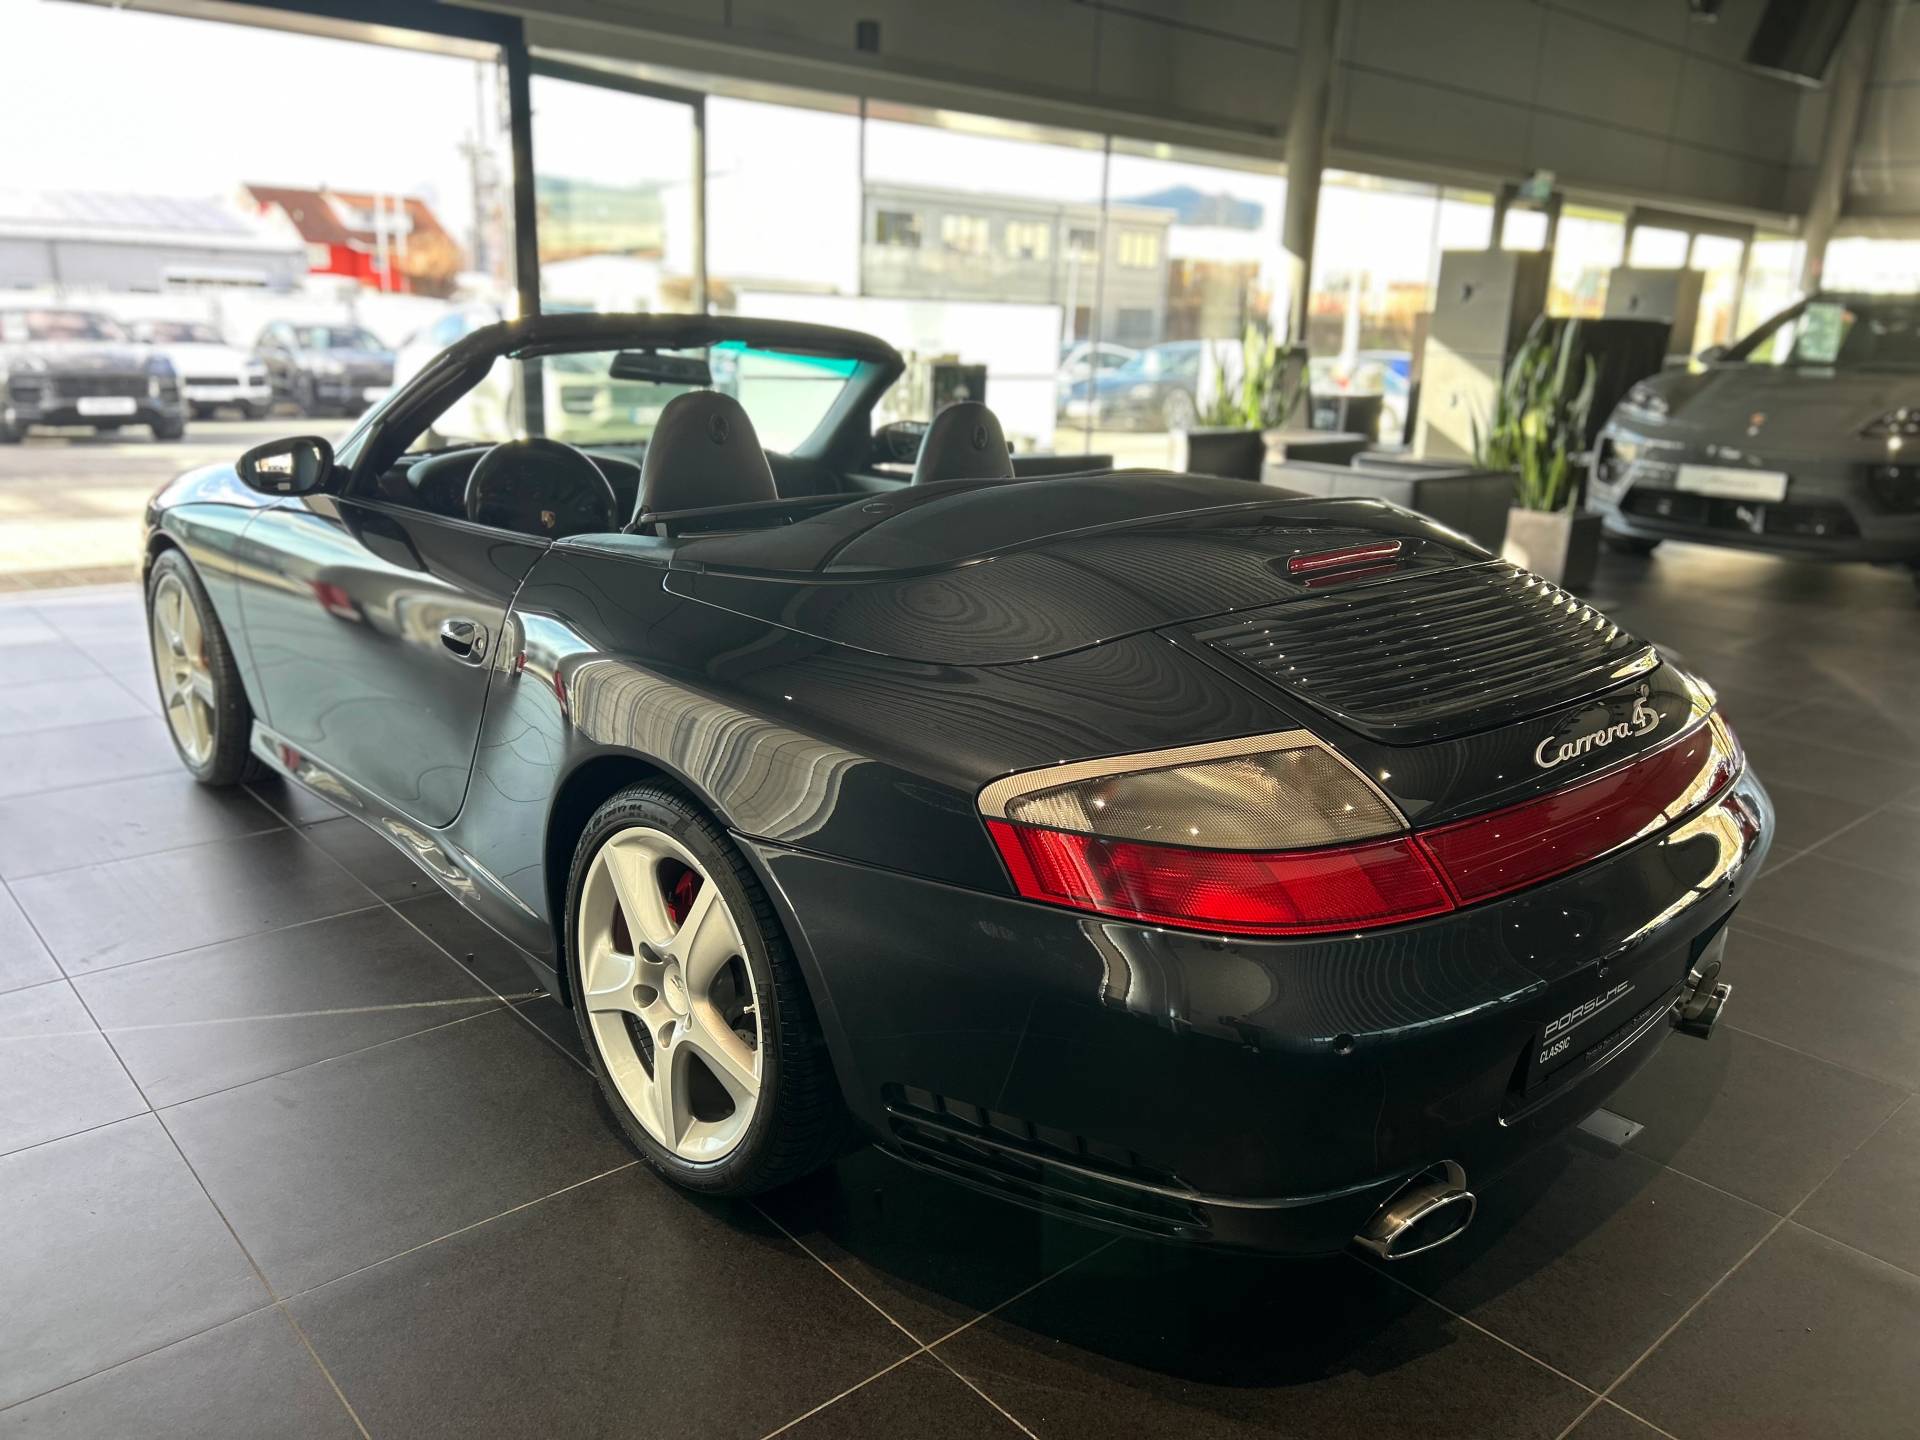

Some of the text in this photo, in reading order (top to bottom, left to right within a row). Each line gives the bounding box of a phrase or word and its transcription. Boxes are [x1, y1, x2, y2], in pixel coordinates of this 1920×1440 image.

[1535, 721, 1633, 769] Carrera
[1544, 980, 1629, 1038] PORSCHE
[1539, 1036, 1571, 1064] CLASSIC
